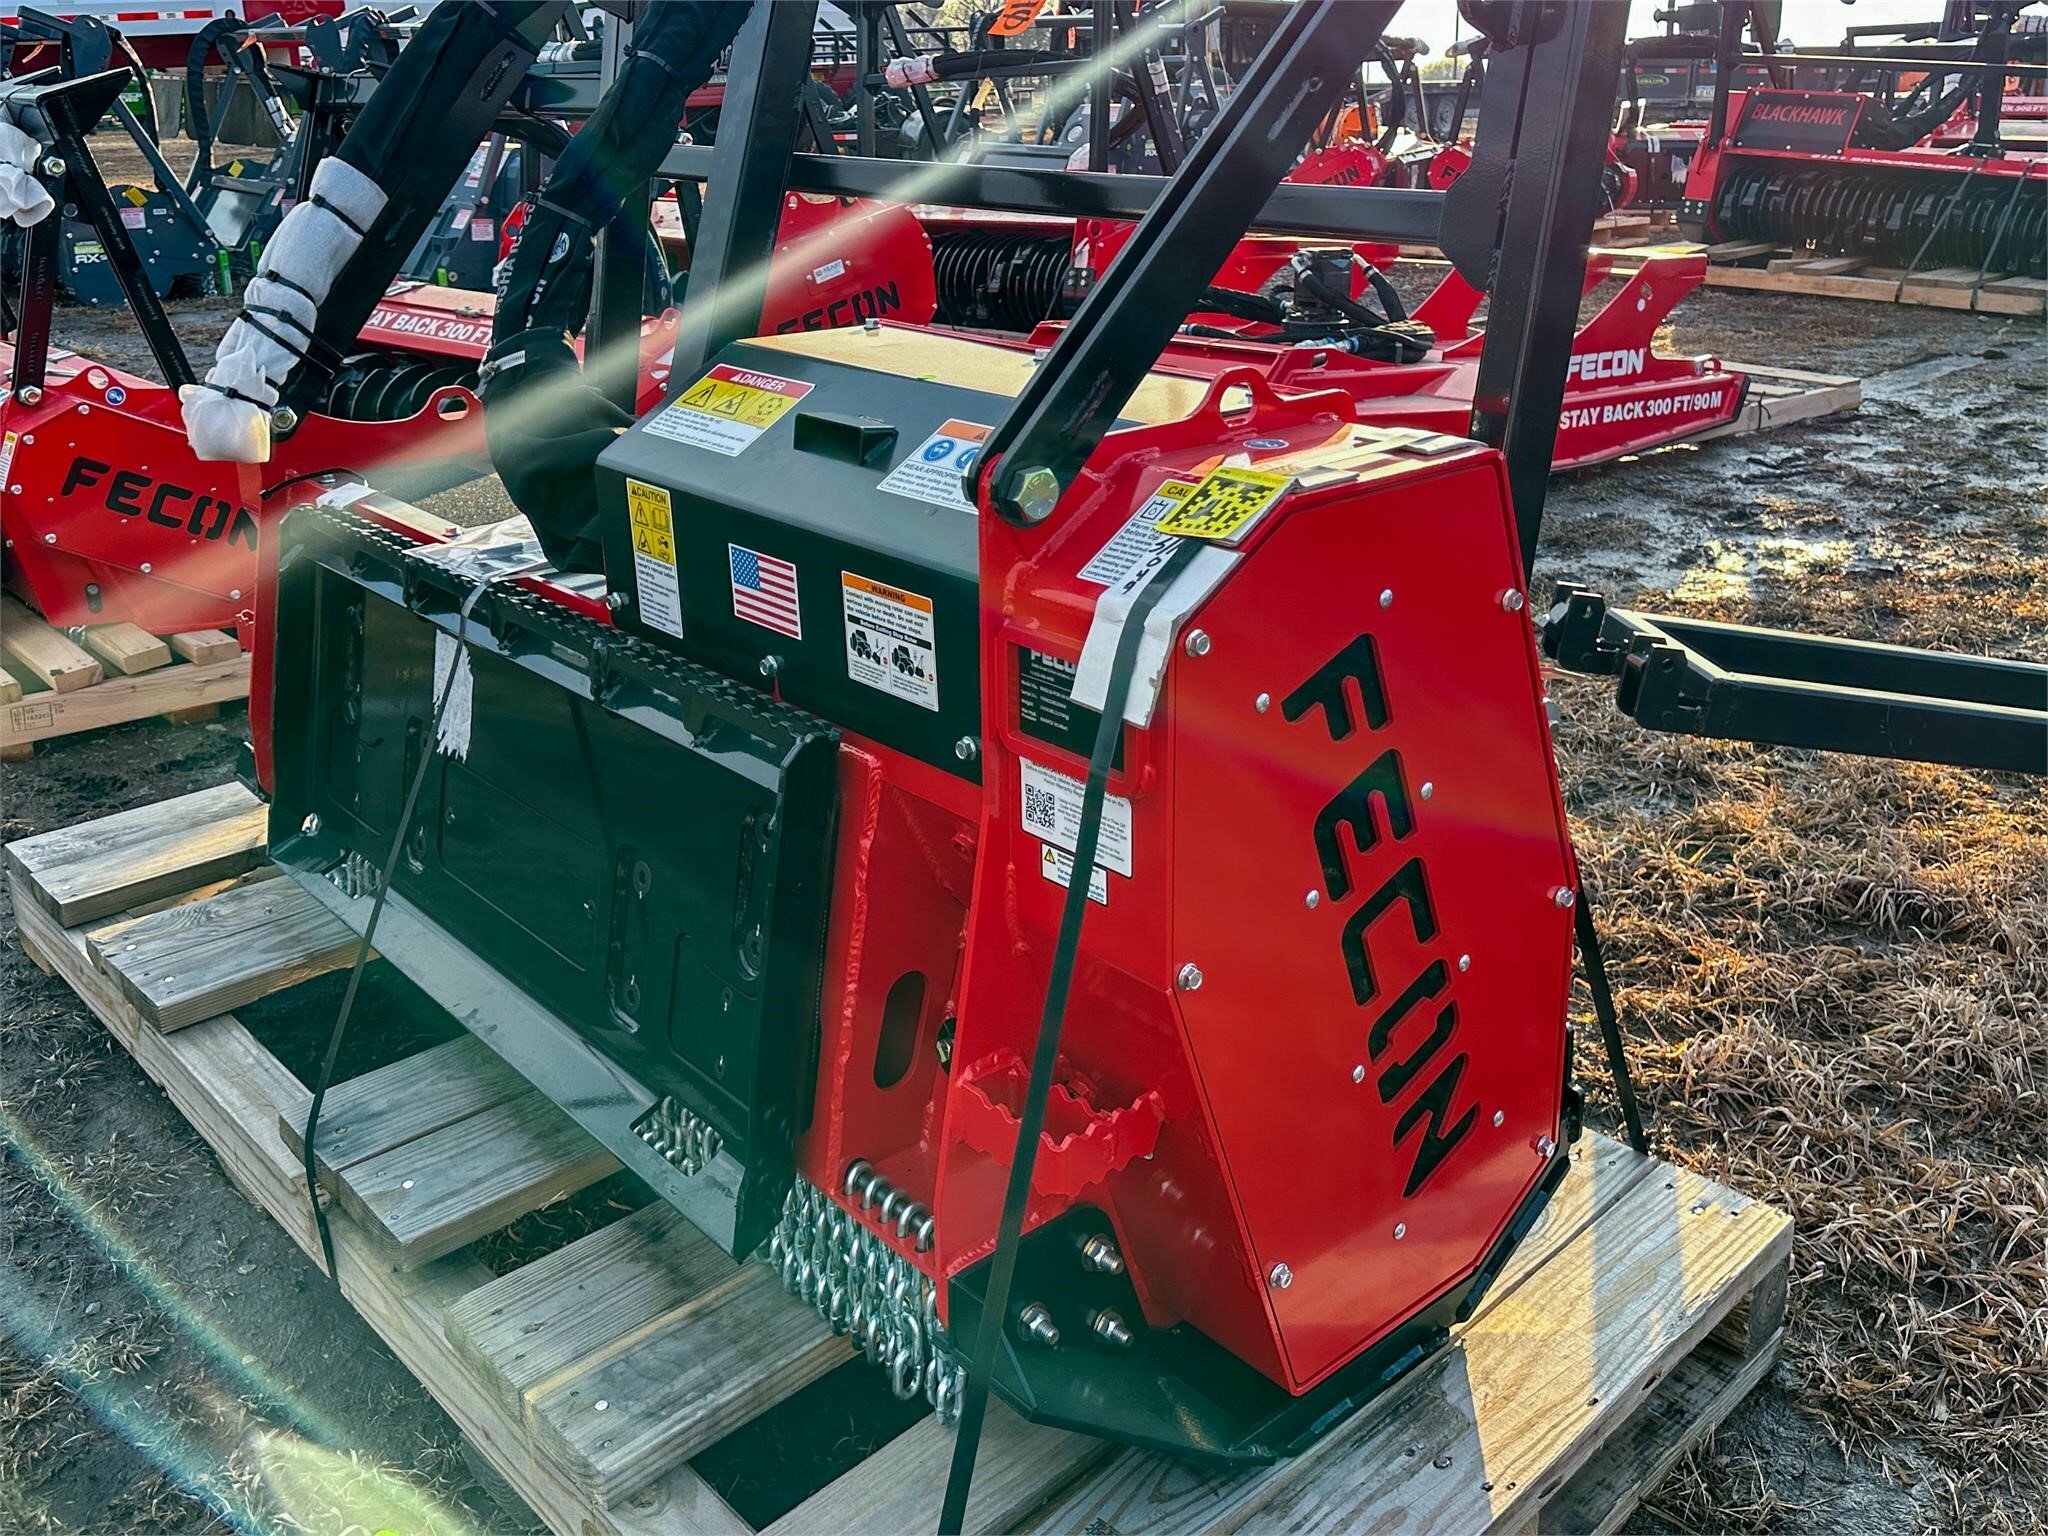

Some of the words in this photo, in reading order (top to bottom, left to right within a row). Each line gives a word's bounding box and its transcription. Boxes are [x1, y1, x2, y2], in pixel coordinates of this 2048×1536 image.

[1751, 103, 1848, 125] BLACKHAWK
[392, 314, 441, 338] BACK
[439, 322, 474, 341] 300
[1566, 347, 1646, 383] FECON
[738, 374, 787, 392] DANGER
[1559, 406, 1600, 430] STAY
[1602, 398, 1646, 423] BACK
[1646, 398, 1672, 417] 300
[636, 487, 667, 505] CAUTION
[1167, 486, 1189, 498] CAU
[61, 456, 258, 552] FECON
[1124, 529, 1146, 538] Before
[1131, 522, 1149, 530] Warm
[871, 585, 904, 601] WARNING
[1031, 648, 1076, 674] FECO
[1282, 633, 1480, 1199] FECON
